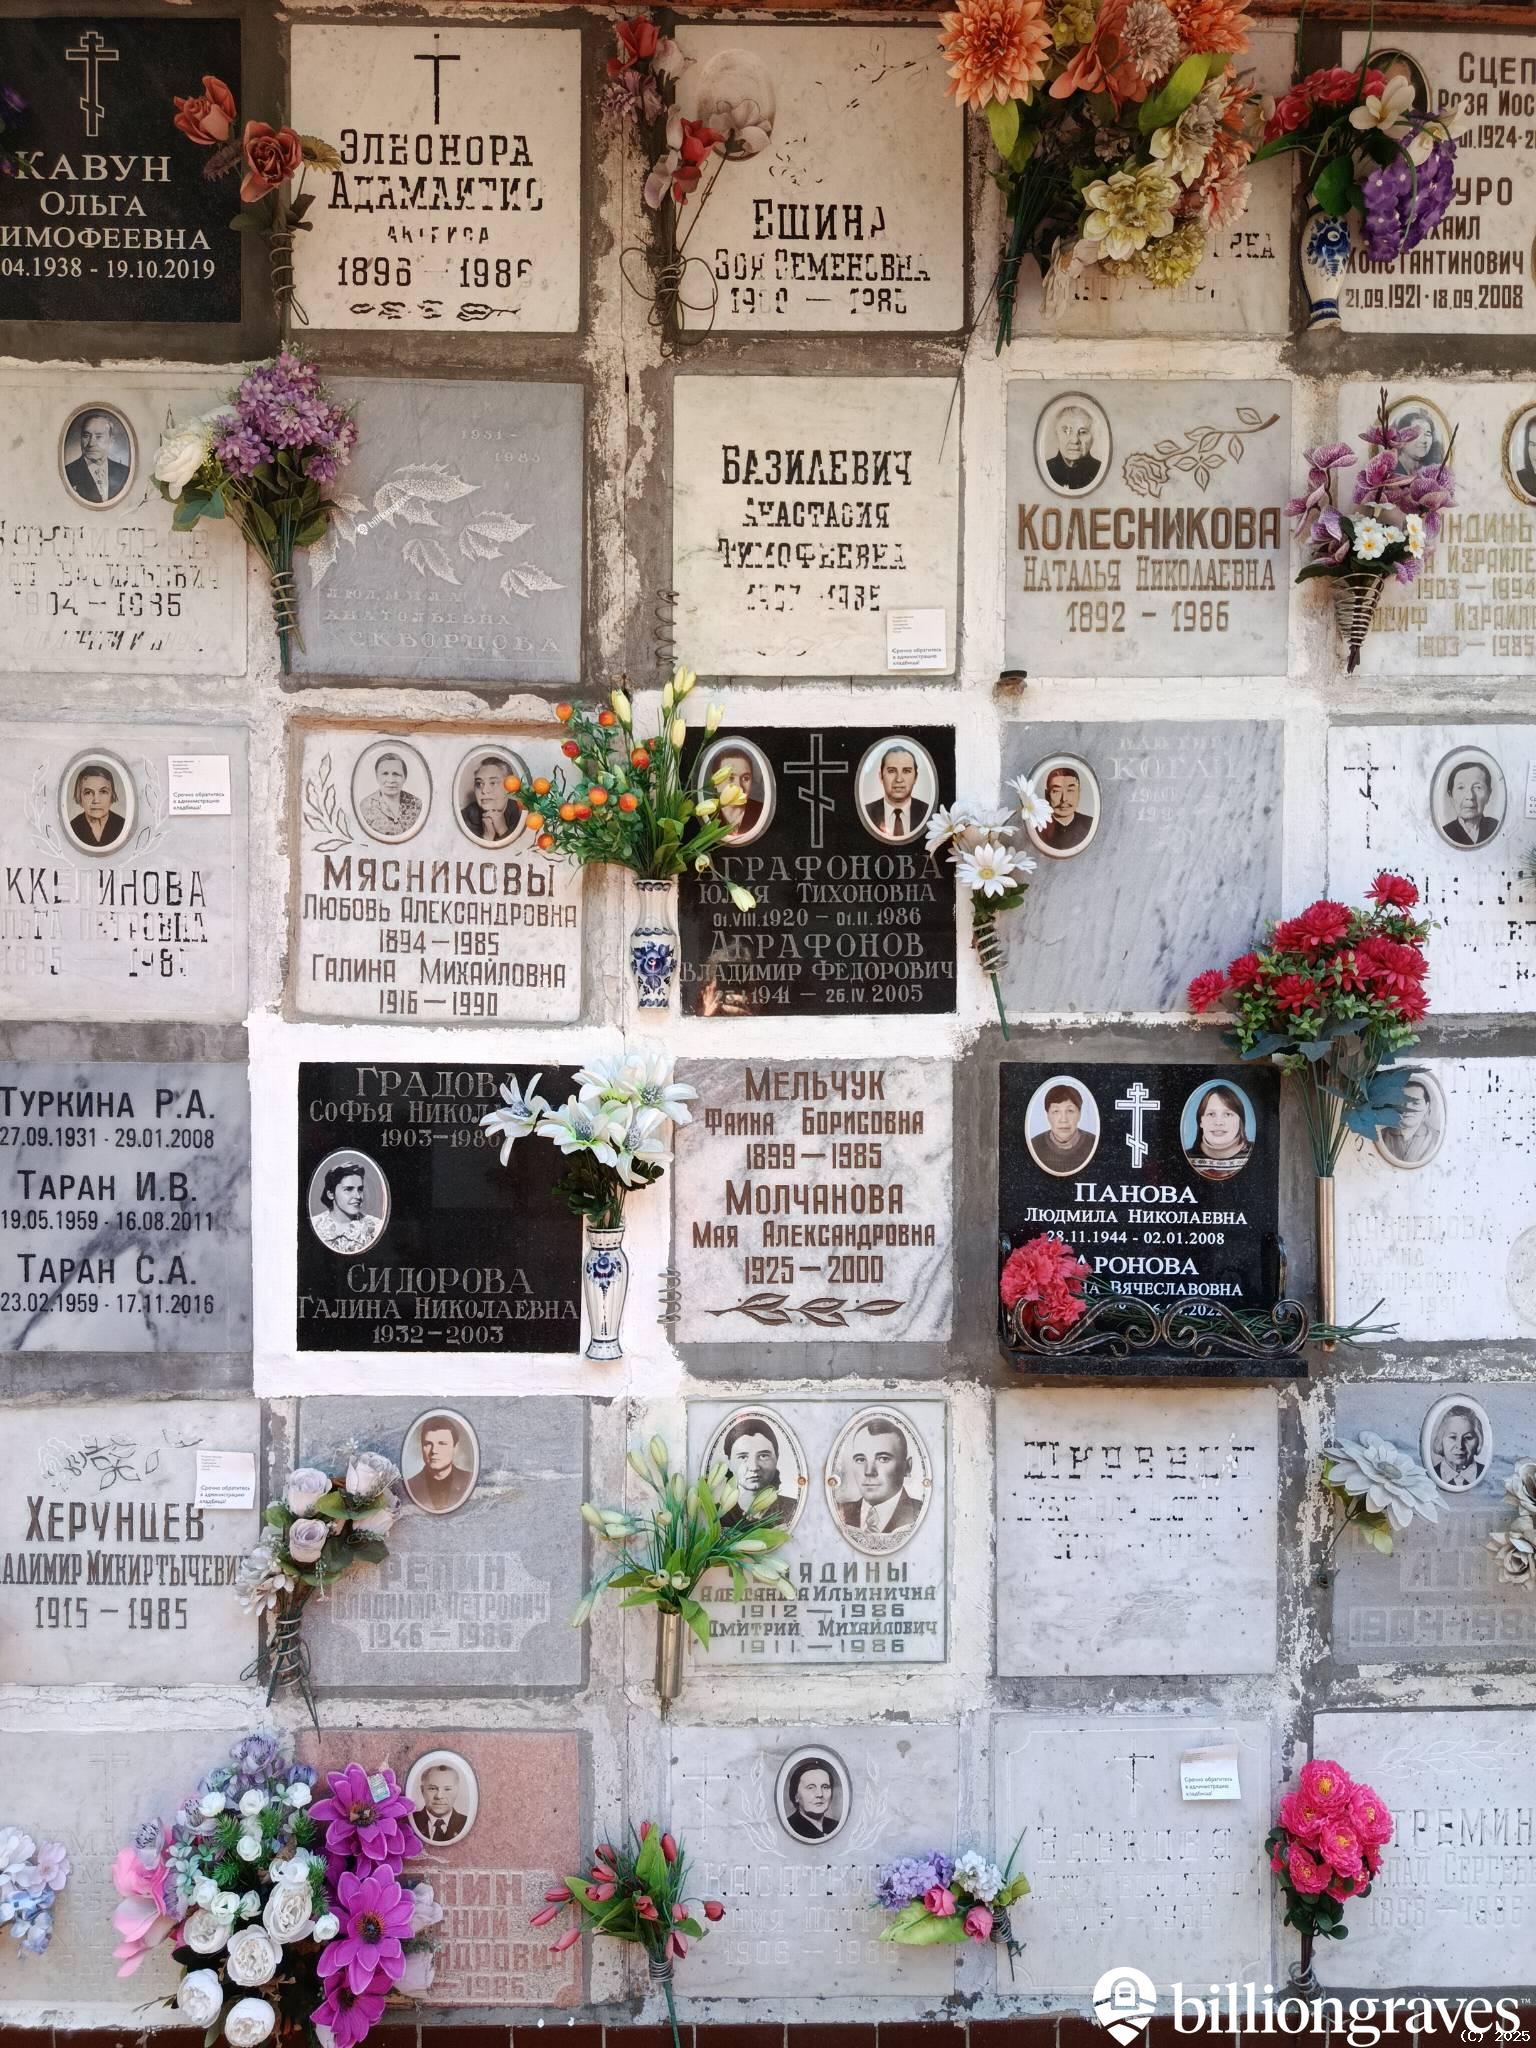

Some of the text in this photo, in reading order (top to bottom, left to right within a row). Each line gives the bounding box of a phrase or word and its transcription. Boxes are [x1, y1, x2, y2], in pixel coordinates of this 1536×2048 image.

[341, 129, 533, 167] ЭЛЕОНОРА
[15, 151, 172, 182] КАВУН
[40, 191, 148, 217] ОЛЬГА
[1453, 177, 1513, 206] УРО
[107, 258, 215, 281] 19.10.2019
[338, 257, 412, 287] 1896
[1433, 285, 1523, 311] 18.09.2008
[722, 445, 912, 486] БАЗИЛЕВИЧ
[1018, 504, 1281, 550] КОЛЕСНИКОВА
[1023, 555, 1275, 592] НАТАЛЬЯ НИКОЛАЕВНА
[1066, 601, 1126, 632] 1892
[1171, 601, 1230, 632] 1986
[350, 632, 560, 653] СКВОРЦОВА
[323, 855, 554, 897] МЯСНИКОВЫ
[694, 855, 944, 881] АГРАФОНОВА
[700, 883, 936, 905] ЮЛЯ ТИХОНОВНА
[303, 894, 577, 928] ЛЮБОВЬ АЛЕКСАНДРОВНА
[380, 929, 499, 956] 1894 1985
[710, 930, 924, 959] АГРАФОНОВ
[312, 954, 566, 988] ГАЛИНА МИХАЙЛОВНА
[680, 962, 802, 984] ВЛАДИМИР
[380, 990, 498, 1017] 1916 1990
[745, 1067, 885, 1101] МЕЛЬЧУК
[0, 1086, 215, 1119] ТУРКИНА Р.А.
[310, 1100, 393, 1122] СОФЬЯ
[705, 1107, 924, 1136] ФАИНА БОРИСОВНА
[0, 1126, 97, 1147] 27.09.1931
[115, 1128, 214, 1149] 29.01.2008
[746, 1143, 795, 1170] 1899
[832, 1143, 882, 1170] 1985
[17, 1170, 197, 1201] ТАРАН И.В.
[726, 1180, 904, 1216] МОЛЧАНОВА
[1074, 1182, 1199, 1204] ПАНОВА
[1, 1210, 98, 1230] 19.05.1959
[117, 1211, 212, 1231] 16.08.2011
[1024, 1207, 1248, 1225] ЛЮДМИЛА НИКОЛАЕВНА
[692, 1221, 936, 1250] МАЯ АЛЕКСАНДРОВНА
[1046, 1230, 1128, 1244] 28.11.1944
[1143, 1231, 1225, 1245] 02.01.2008
[17, 1254, 196, 1285] ТАРАН С.А.
[347, 1264, 534, 1295] СИДОРОВА
[745, 1256, 794, 1284] 1925
[828, 1255, 884, 1284] 2000
[0, 1292, 98, 1313] 23.02.1959
[116, 1294, 214, 1314] 17.11.2016
[1110, 1281, 1243, 1297] ВЯЧЕСЛАВОВНА
[297, 1296, 579, 1320] ГАЛИНА НИКОЛАЕВНА
[372, 1325, 504, 1345] 1932 2003
[26, 1496, 204, 1543] ХЕРУНЦЕВ
[0, 1553, 82, 1586] АДИМИР
[35, 1597, 88, 1629] 1915
[128, 1598, 188, 1629] 1985
[741, 1605, 797, 1618] 1912
[841, 1603, 905, 1618] 1986
[709, 1619, 937, 1637] ДМИТРИЙ МИХАЙЛОВИЧ
[741, 1640, 795, 1653] 1911
[841, 1639, 905, 1653] 1986
[1390, 1808, 1534, 1848] ТРЕМИН
